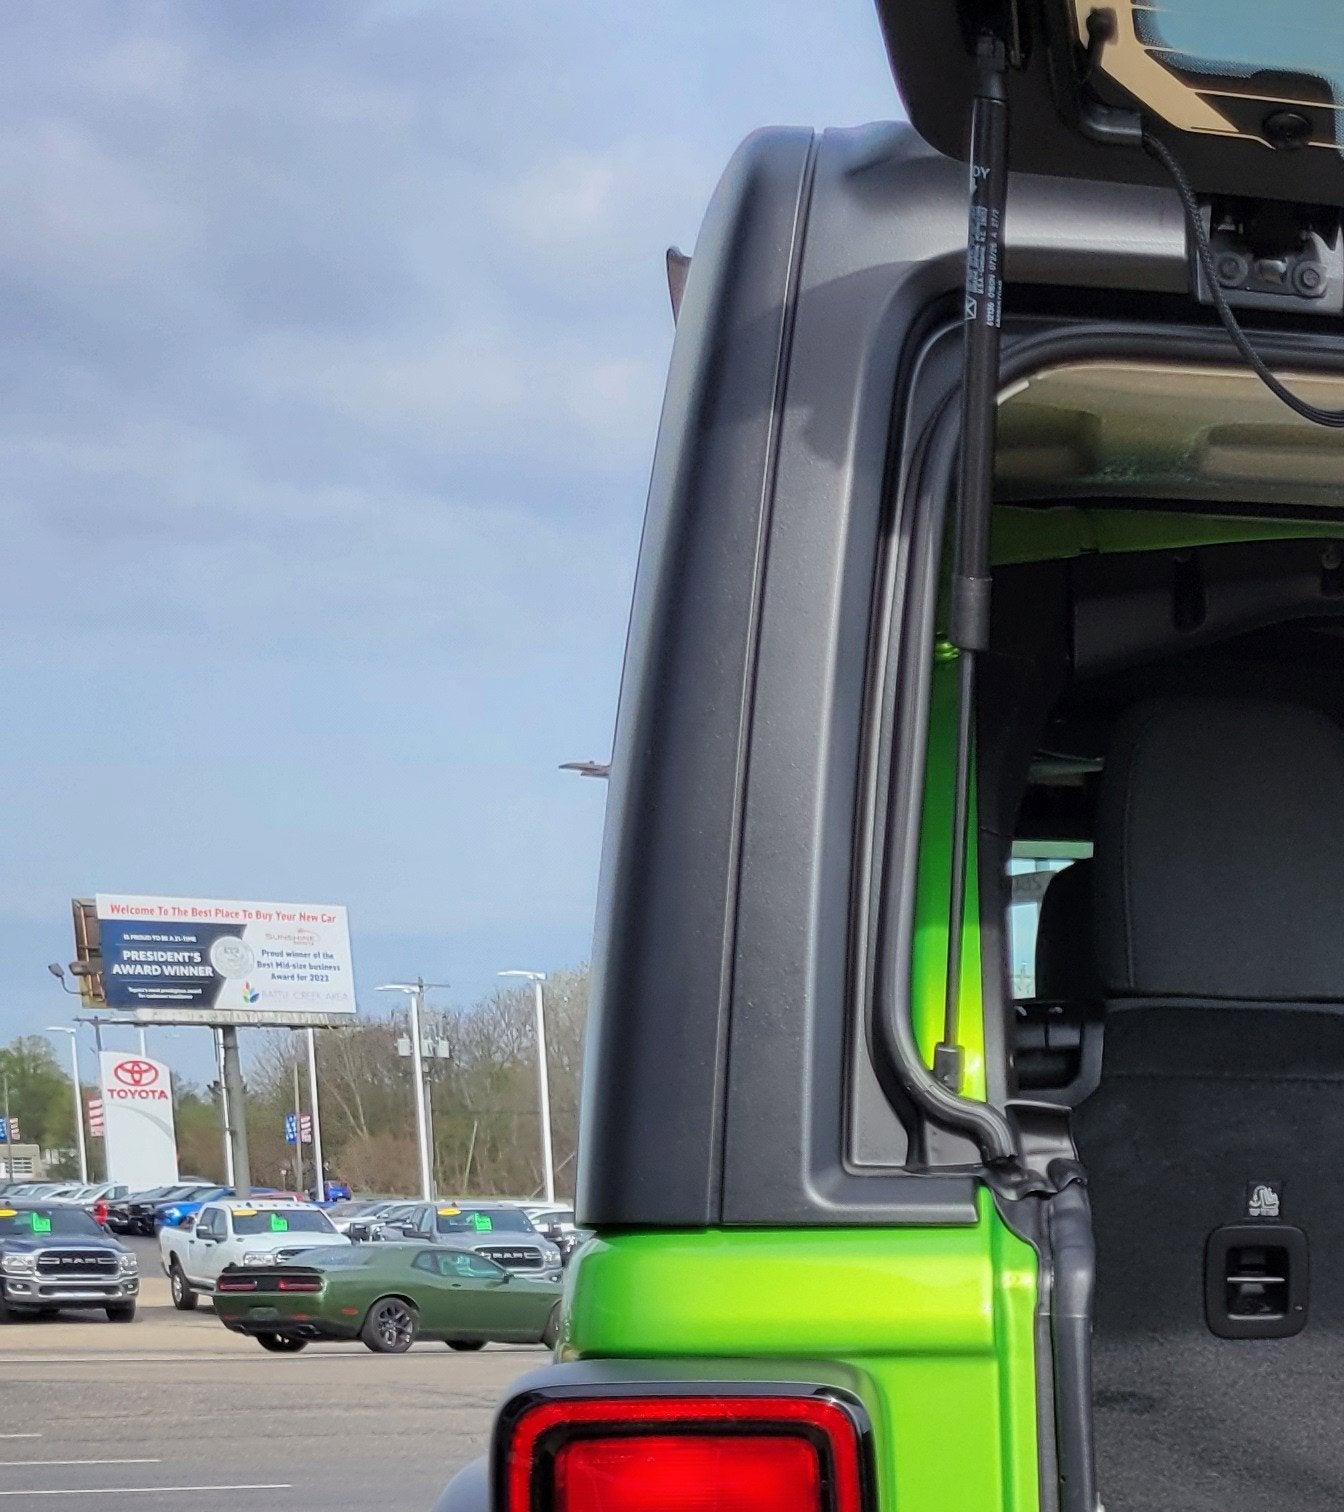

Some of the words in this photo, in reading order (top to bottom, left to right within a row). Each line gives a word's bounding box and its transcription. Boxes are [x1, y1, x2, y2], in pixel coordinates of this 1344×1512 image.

[110, 904, 154, 916] Welcome
[158, 906, 169, 916] To
[172, 907, 188, 917] The
[191, 907, 212, 918] Best
[215, 908, 240, 919] Place
[242, 910, 253, 919] To
[255, 910, 273, 921] Buy
[275, 911, 297, 920] Your
[299, 912, 318, 922] New
[321, 913, 336, 923] Car
[122, 950, 202, 963] PRESIDENT'S
[261, 949, 284, 958] Proud
[322, 951, 334, 960] the
[112, 964, 161, 976] AWARD
[162, 965, 214, 977] WINNER
[256, 960, 274, 969] Best
[275, 961, 307, 970] Mid-size
[308, 962, 341, 971] business
[271, 973, 295, 981] Award
[107, 1089, 168, 1100] TOYOTA
